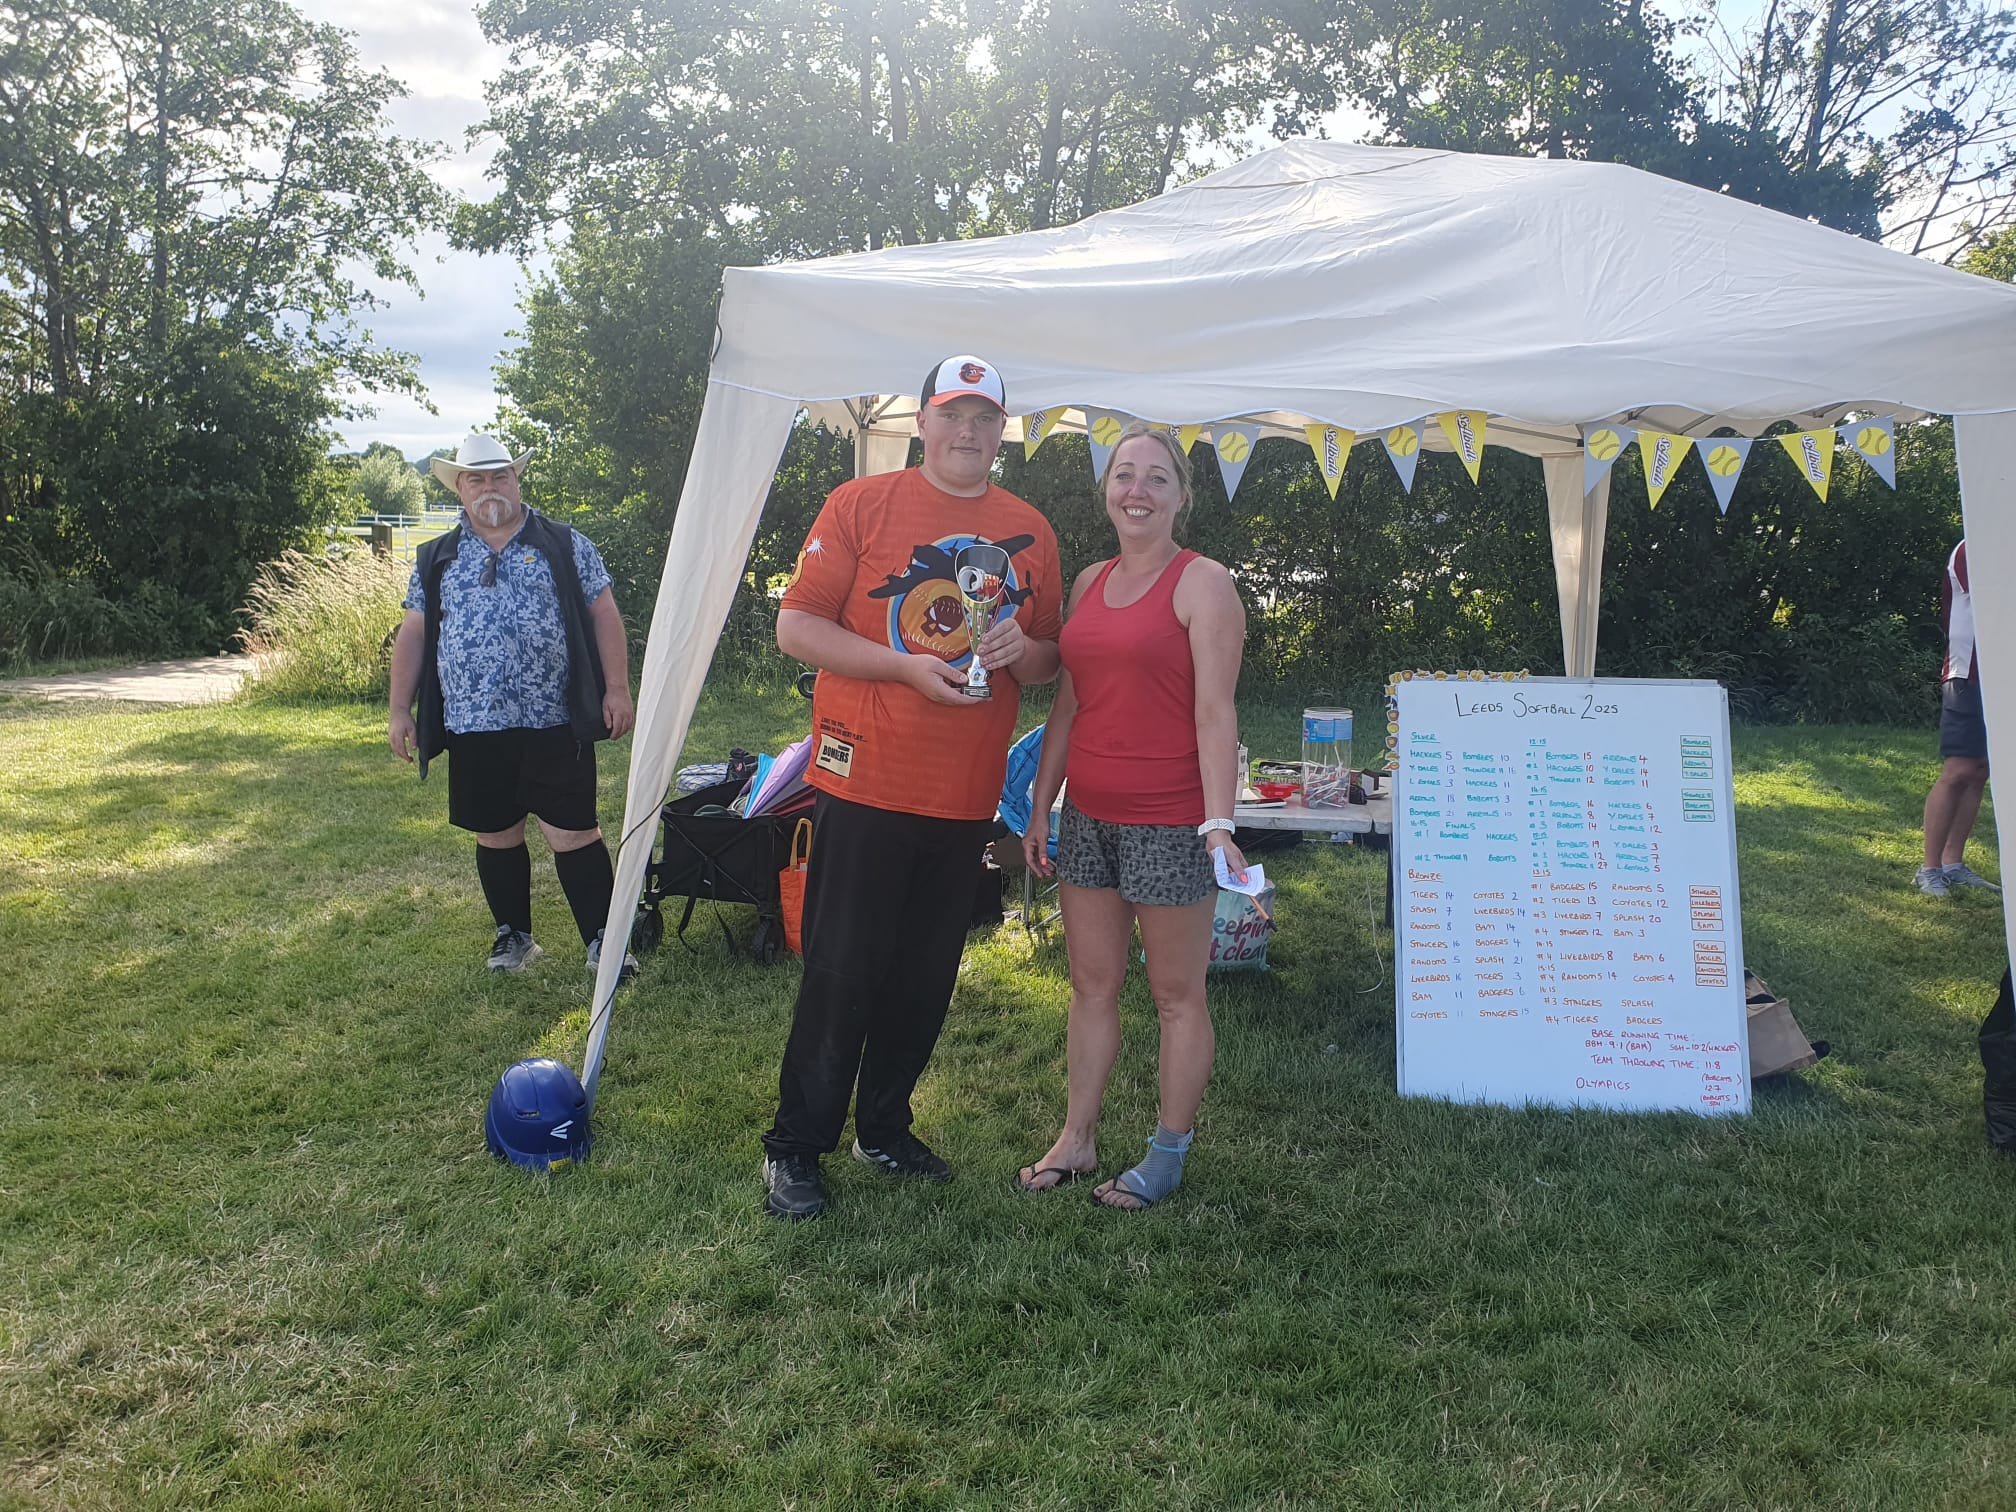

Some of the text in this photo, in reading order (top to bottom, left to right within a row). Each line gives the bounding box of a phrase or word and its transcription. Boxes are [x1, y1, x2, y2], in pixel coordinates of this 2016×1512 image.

[1457, 414, 1478, 463] Softball
[1324, 427, 1340, 478] Softball
[1651, 436, 1671, 488] Softball
[1801, 435, 1826, 482] Softball
[1455, 692, 1619, 719] LEEDS SOFTBALL 2025
[1445, 750, 1453, 761] 5
[1583, 751, 1593, 761] 15
[1638, 754, 1649, 765] 4
[1585, 764, 1594, 773] 10
[1640, 768, 1649, 777] 14
[1586, 776, 1595, 784] 12
[1641, 779, 1649, 789] 11
[1504, 795, 1511, 804] 3
[1646, 802, 1653, 810] 6
[1587, 811, 1595, 820] 8
[1647, 813, 1655, 821] 7
[1445, 821, 1477, 831] FINALS
[1588, 822, 1598, 831] 14
[1649, 824, 1663, 834] 12
[1591, 840, 1600, 849] 19
[1650, 842, 1659, 851] 3
[1594, 852, 1606, 861] 12
[1650, 853, 1660, 863] 7
[1597, 861, 1609, 870] 27
[1653, 864, 1661, 873] 5
[1408, 868, 1441, 880] BRONZE
[1588, 882, 1598, 890] 15
[1611, 883, 1665, 893] RANDOMS 5
[1410, 890, 1454, 900] TIGERS 14
[1473, 892, 1519, 901] COYOTES 2
[1587, 896, 1597, 905] 13
[1611, 899, 1669, 909] COYOTES 12
[1410, 905, 1453, 917] SPLASH 7
[1473, 907, 1526, 917] LIVERBIRDS 14
[1595, 911, 1602, 921] 7
[1613, 913, 1662, 924] SPLASH 20
[1475, 923, 1516, 932] BAM 14
[1592, 928, 1604, 937] 12
[1637, 929, 1646, 938] 3
[1410, 939, 1449, 949] STINGERS
[1475, 938, 1520, 948] BADGERS 4
[1474, 956, 1523, 965] SPLASH 21
[1560, 951, 1605, 961] LIVERBIRDS
[1607, 950, 1614, 961] 8
[1658, 953, 1665, 962] 6
[1411, 958, 1447, 966] RANDOMS
[1411, 974, 1451, 984] LIVERBIRDS
[1474, 972, 1522, 981] TIGERS 3
[1607, 971, 1618, 981] 14
[1633, 973, 1676, 983] COYOTES 4
[1411, 992, 1433, 1001] BAM
[1478, 988, 1514, 998] BADGERS
[1562, 998, 1603, 1008] STINGERS
[1621, 999, 1654, 1008] SPLASH
[1410, 1011, 1448, 1019] COYOTES
[1479, 1007, 1530, 1018] STINGERS 15
[1563, 1015, 1599, 1024] TIGERS
[1626, 1017, 1663, 1025] BADGERS
[1591, 1029, 1615, 1038] BASE
[1621, 1031, 1660, 1041] RUNNING
[1590, 1054, 1613, 1065] TEAM
[1620, 1056, 1666, 1069] THROWING
[1575, 1076, 1631, 1091] OLYMPICS
